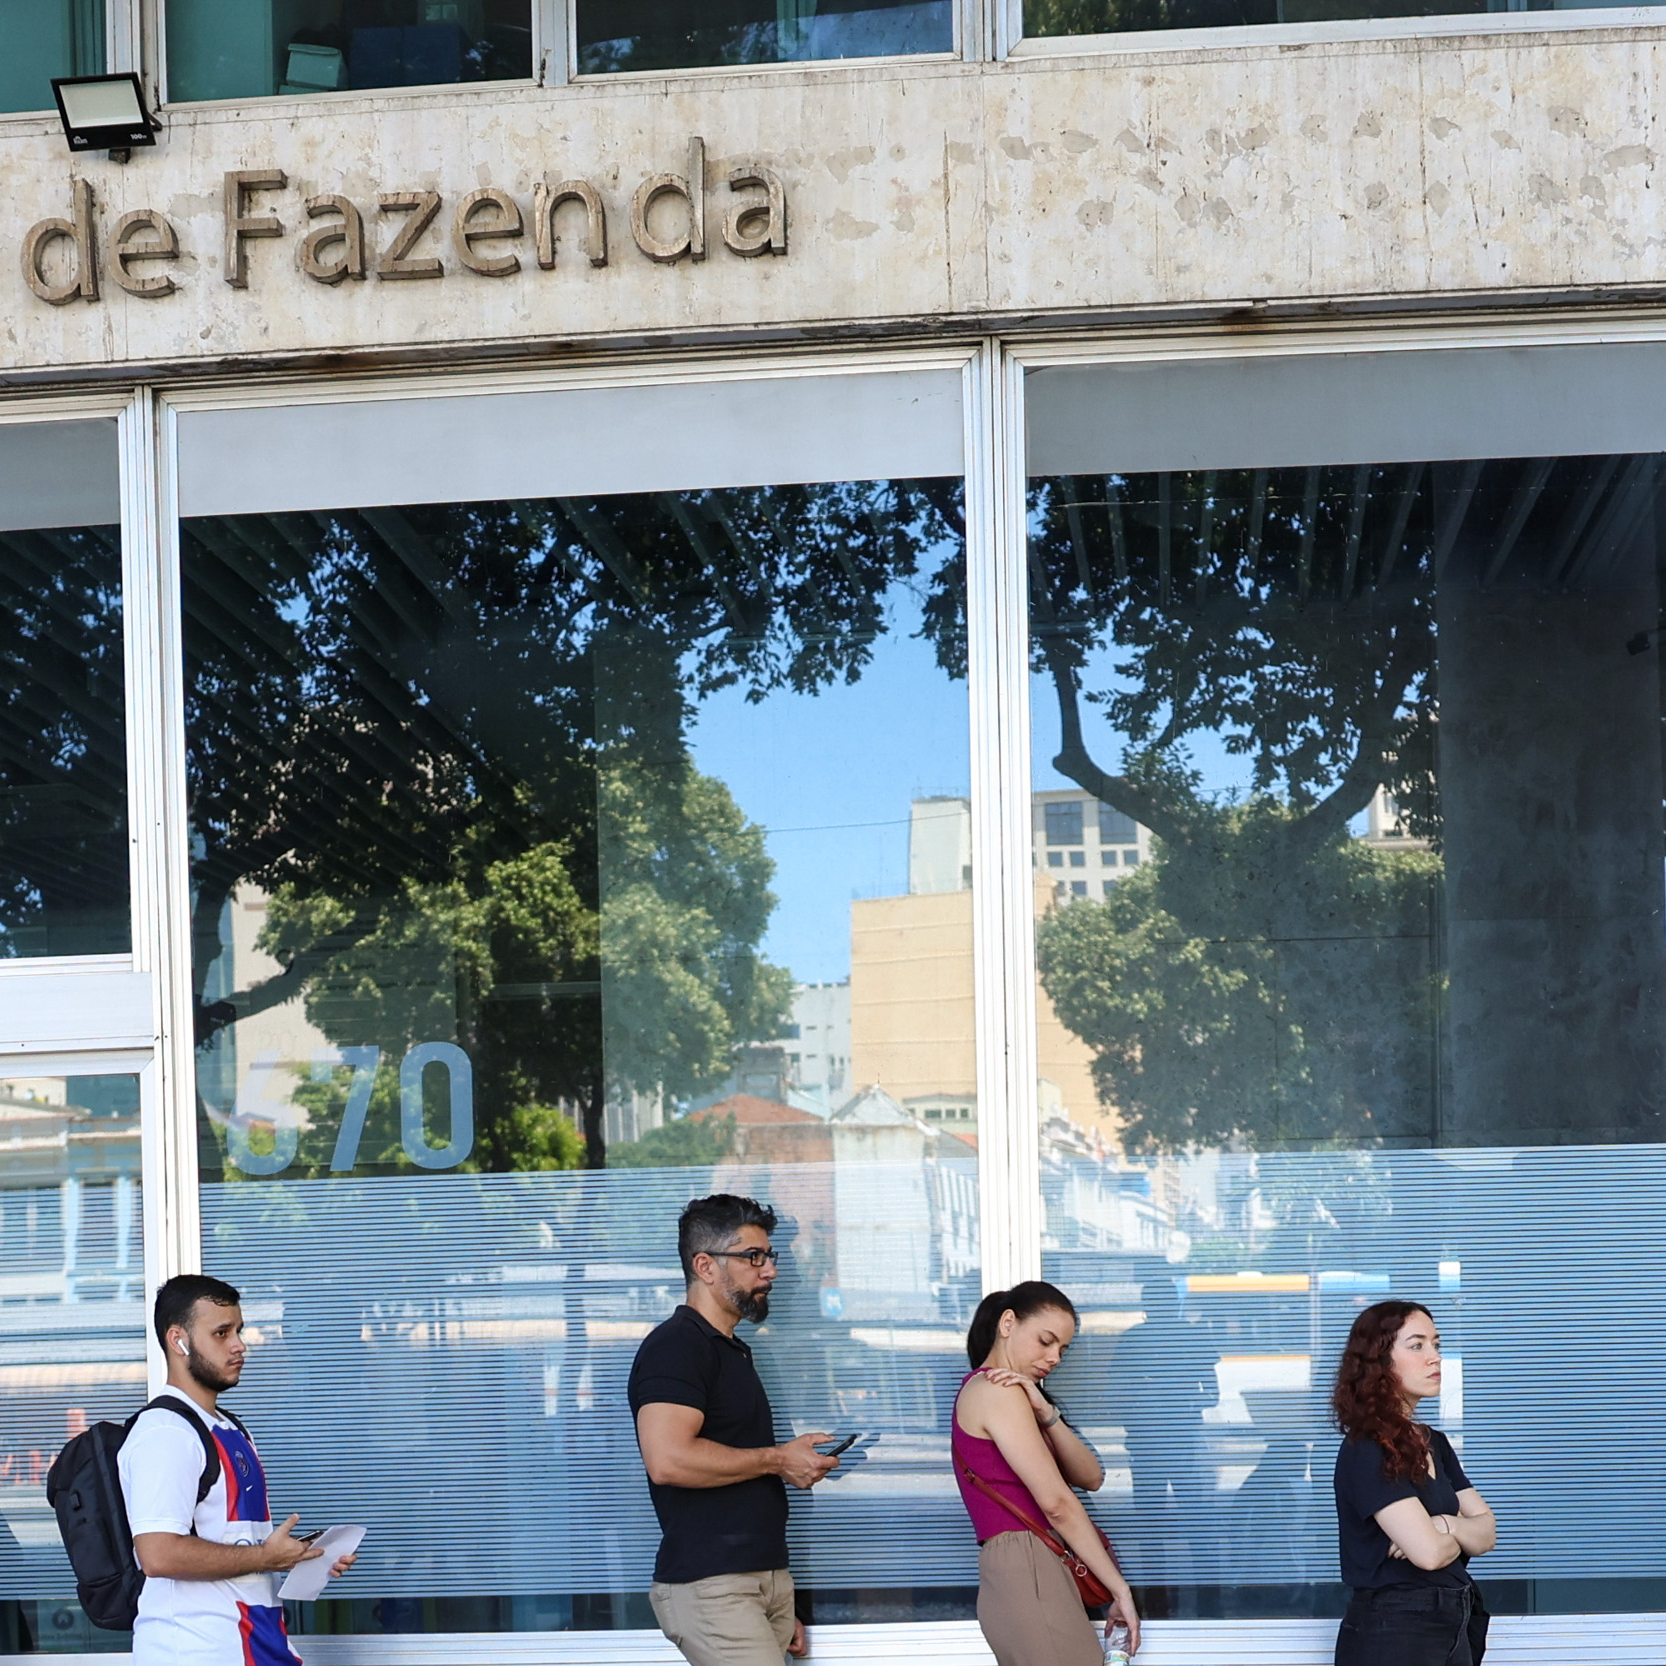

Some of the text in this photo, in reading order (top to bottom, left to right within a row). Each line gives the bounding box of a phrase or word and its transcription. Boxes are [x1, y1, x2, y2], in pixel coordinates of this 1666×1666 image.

[21, 177, 181, 307] de
[224, 135, 787, 289] Fazenda
[227, 1041, 474, 1176] 670
